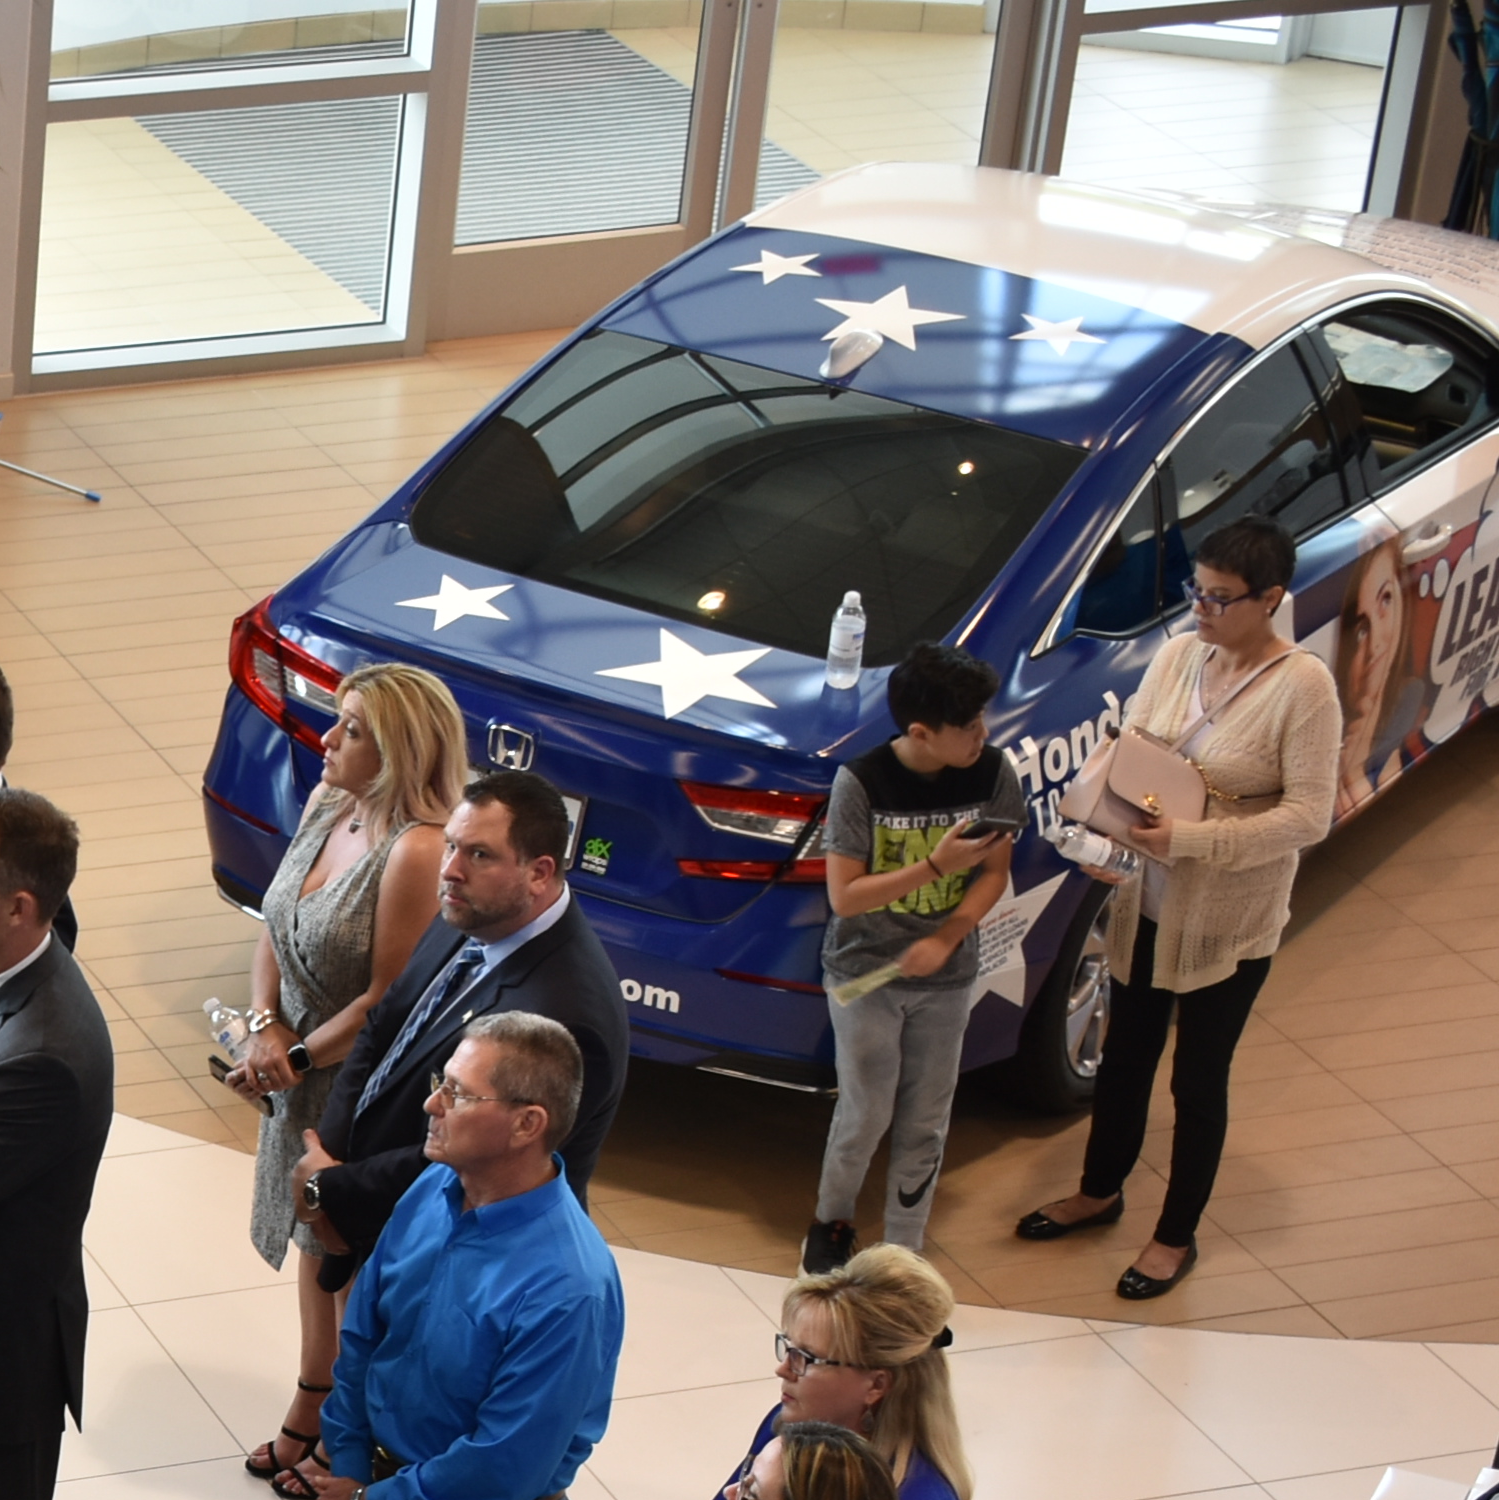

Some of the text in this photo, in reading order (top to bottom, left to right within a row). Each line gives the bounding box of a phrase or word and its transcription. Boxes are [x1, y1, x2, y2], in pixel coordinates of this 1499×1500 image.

[874, 808, 981, 829] TAKE IT TO THE
[619, 978, 680, 1014] om
